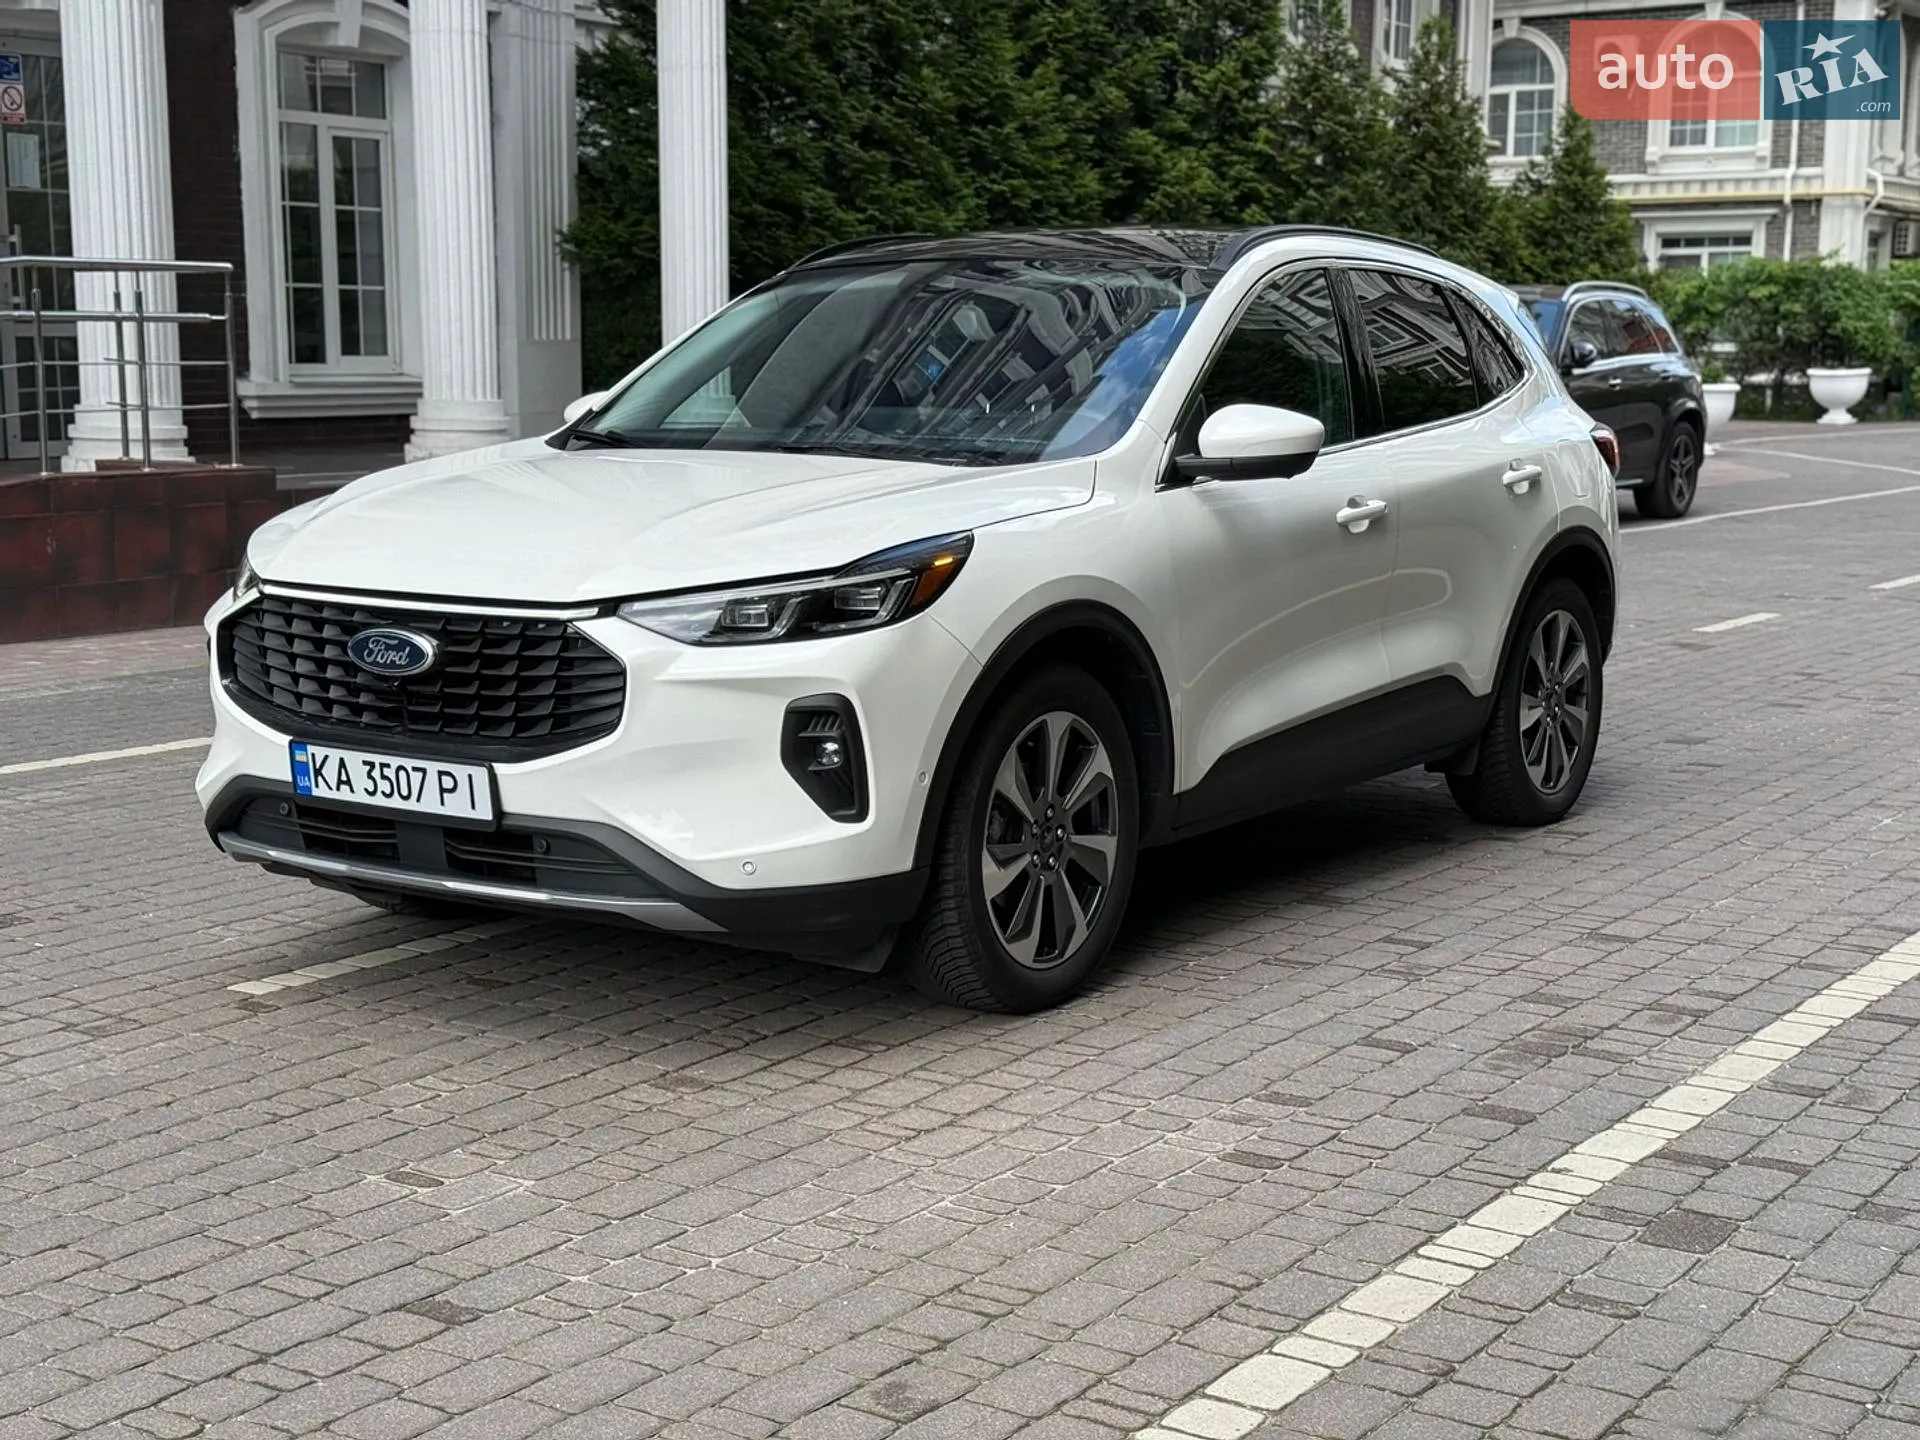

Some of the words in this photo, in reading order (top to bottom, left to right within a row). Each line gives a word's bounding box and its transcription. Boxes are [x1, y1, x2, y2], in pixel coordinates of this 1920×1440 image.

[363, 636, 411, 665] Ford
[297, 775, 310, 787] UA
[311, 752, 355, 794] KA
[362, 760, 427, 803] 3507
[437, 769, 476, 811] PI
